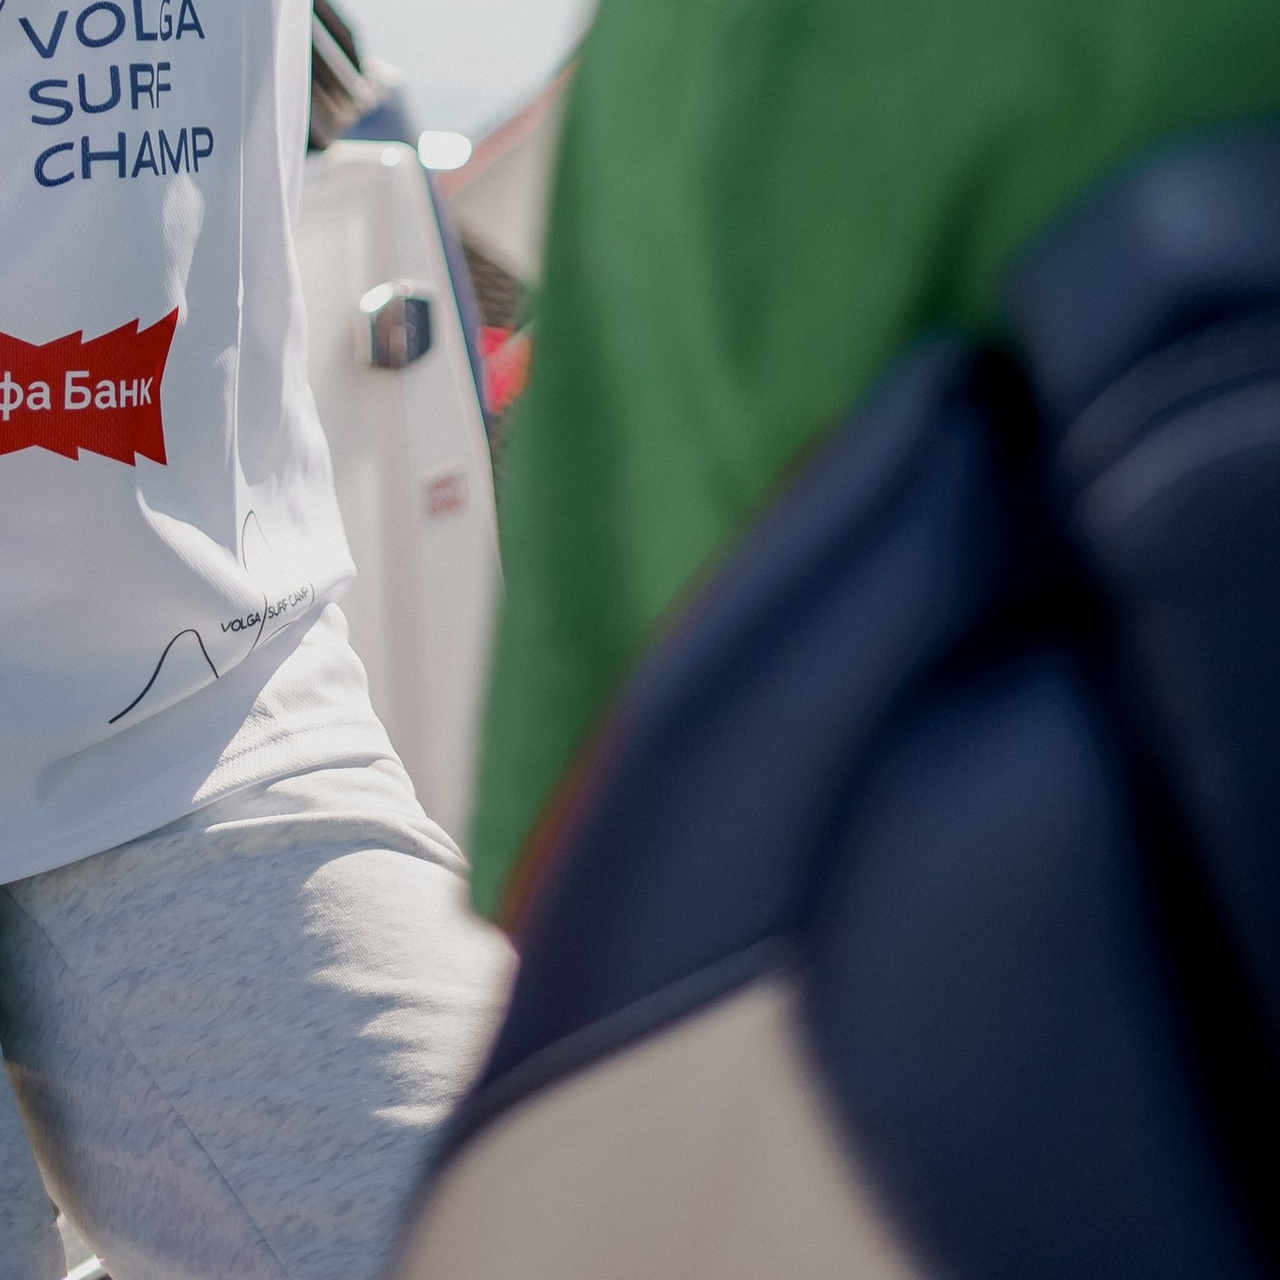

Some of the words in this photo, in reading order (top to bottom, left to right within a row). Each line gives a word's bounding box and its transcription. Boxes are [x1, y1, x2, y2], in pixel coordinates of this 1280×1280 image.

[28, 61, 172, 126] SURF
[33, 126, 214, 188] CHAMP
[64, 370, 154, 411] Банк
[221, 612, 261, 633] VOLGA
